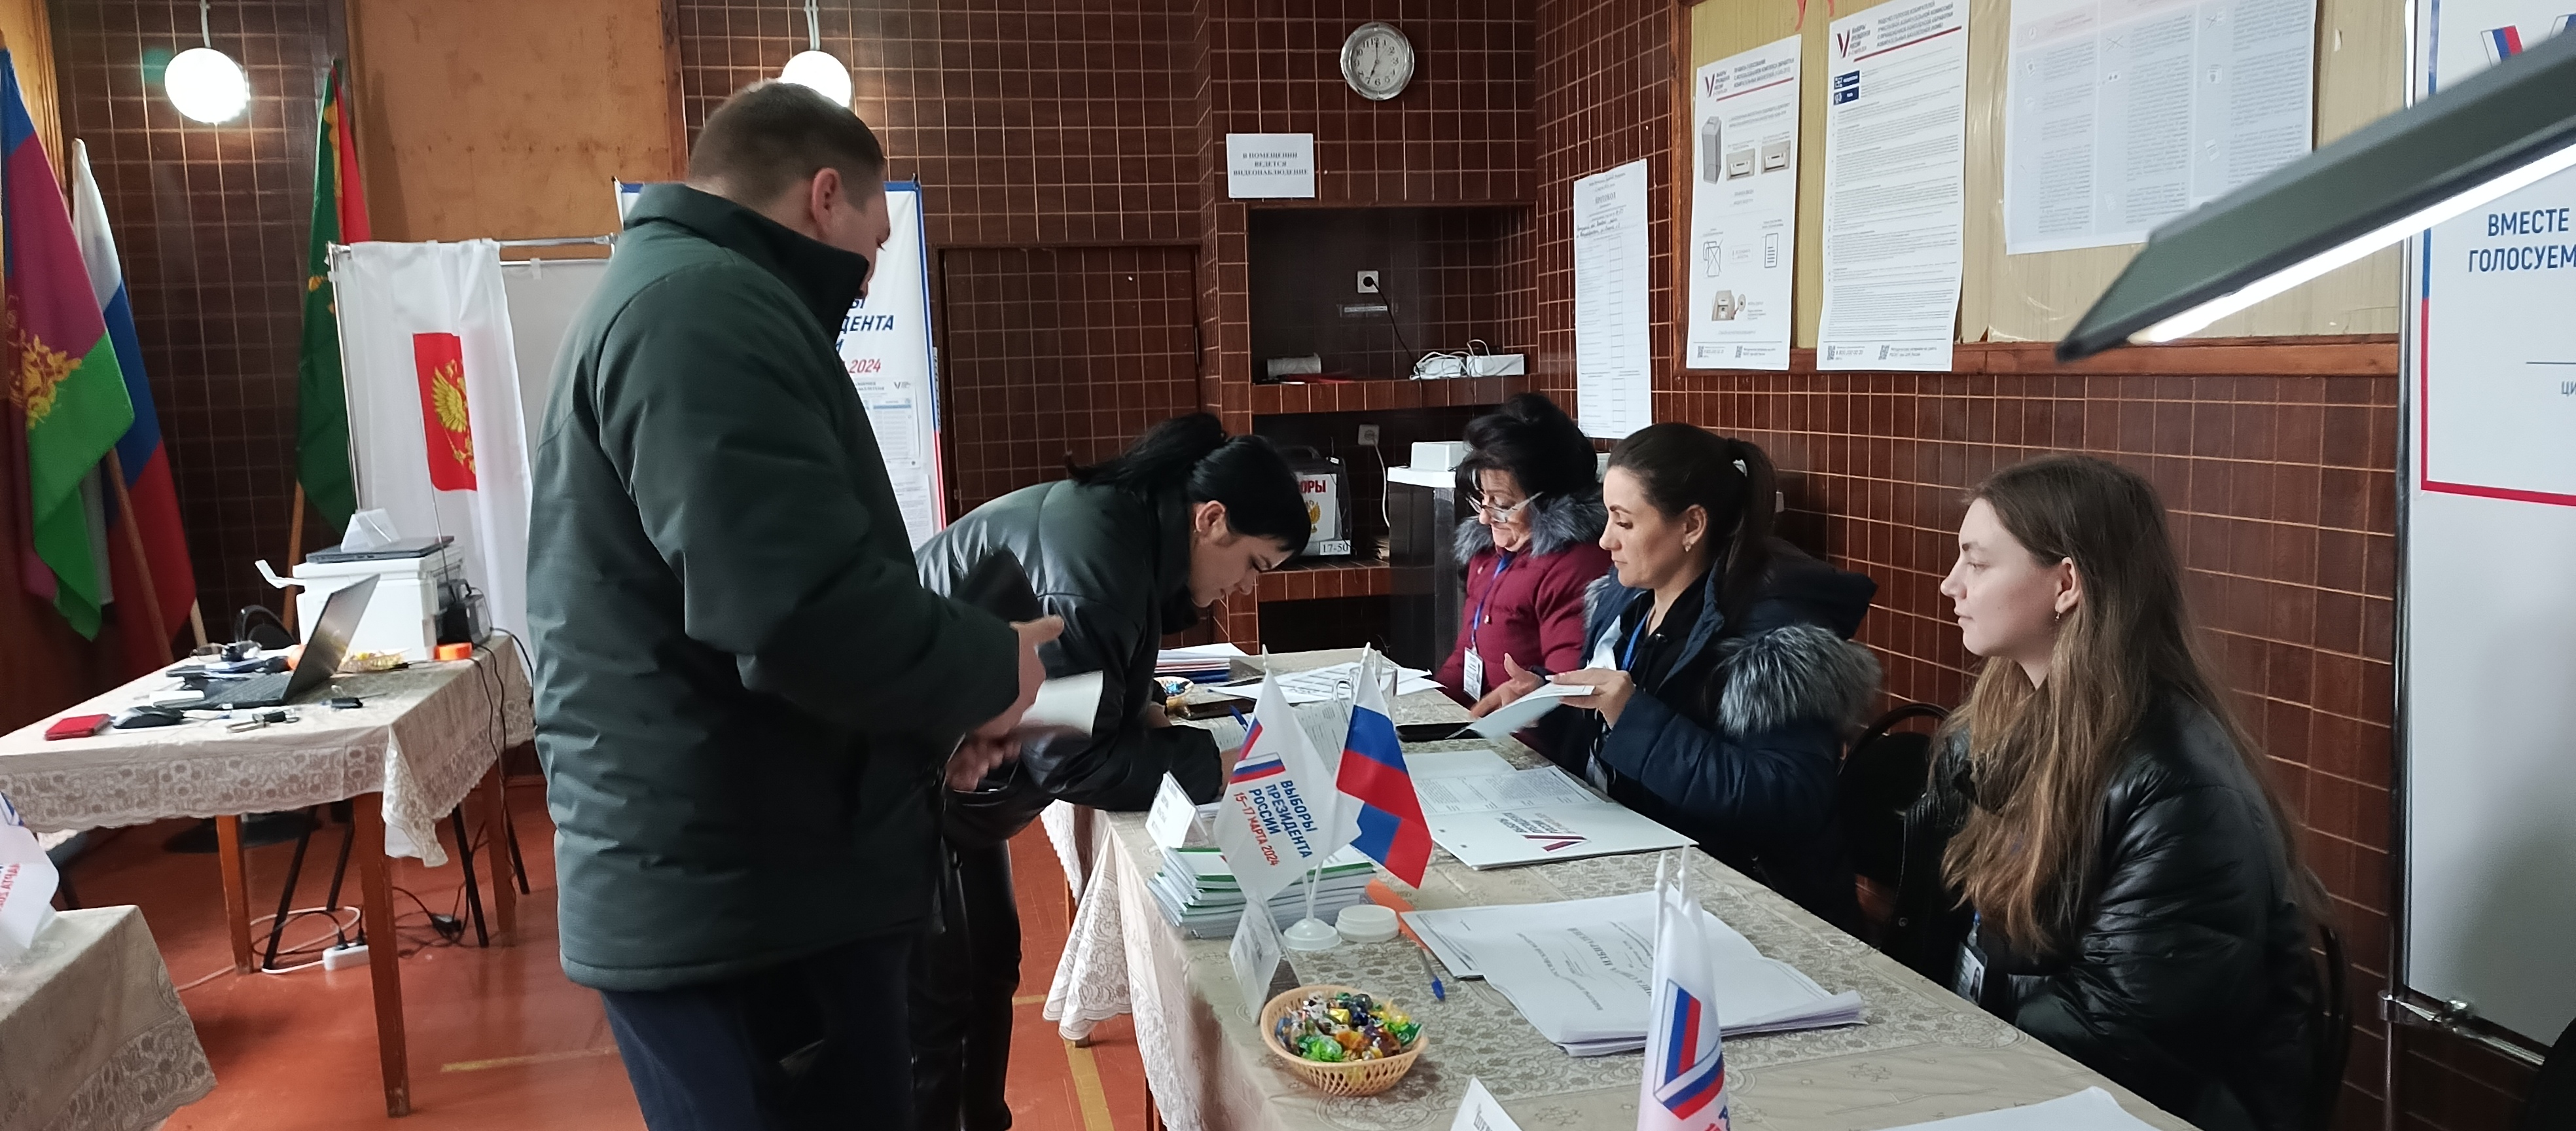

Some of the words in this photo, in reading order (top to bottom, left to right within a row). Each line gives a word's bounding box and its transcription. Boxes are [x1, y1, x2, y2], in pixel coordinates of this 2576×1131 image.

[2488, 207, 2570, 236] ВМЕСТЕ
[2468, 244, 2576, 272] ГОЛОСУЕМ
[841, 315, 894, 334] ДЕНТА
[849, 359, 881, 374] 2024
[1300, 480, 1326, 493] ОРЫ
[1249, 788, 1281, 835] РОССИИ
[1280, 780, 1318, 832] ВЫБОРЫ
[1265, 784, 1313, 858] ПРЕЗИДЕНТА
[1248, 816, 1268, 845] МАРТА
[1261, 844, 1279, 866] 2024
